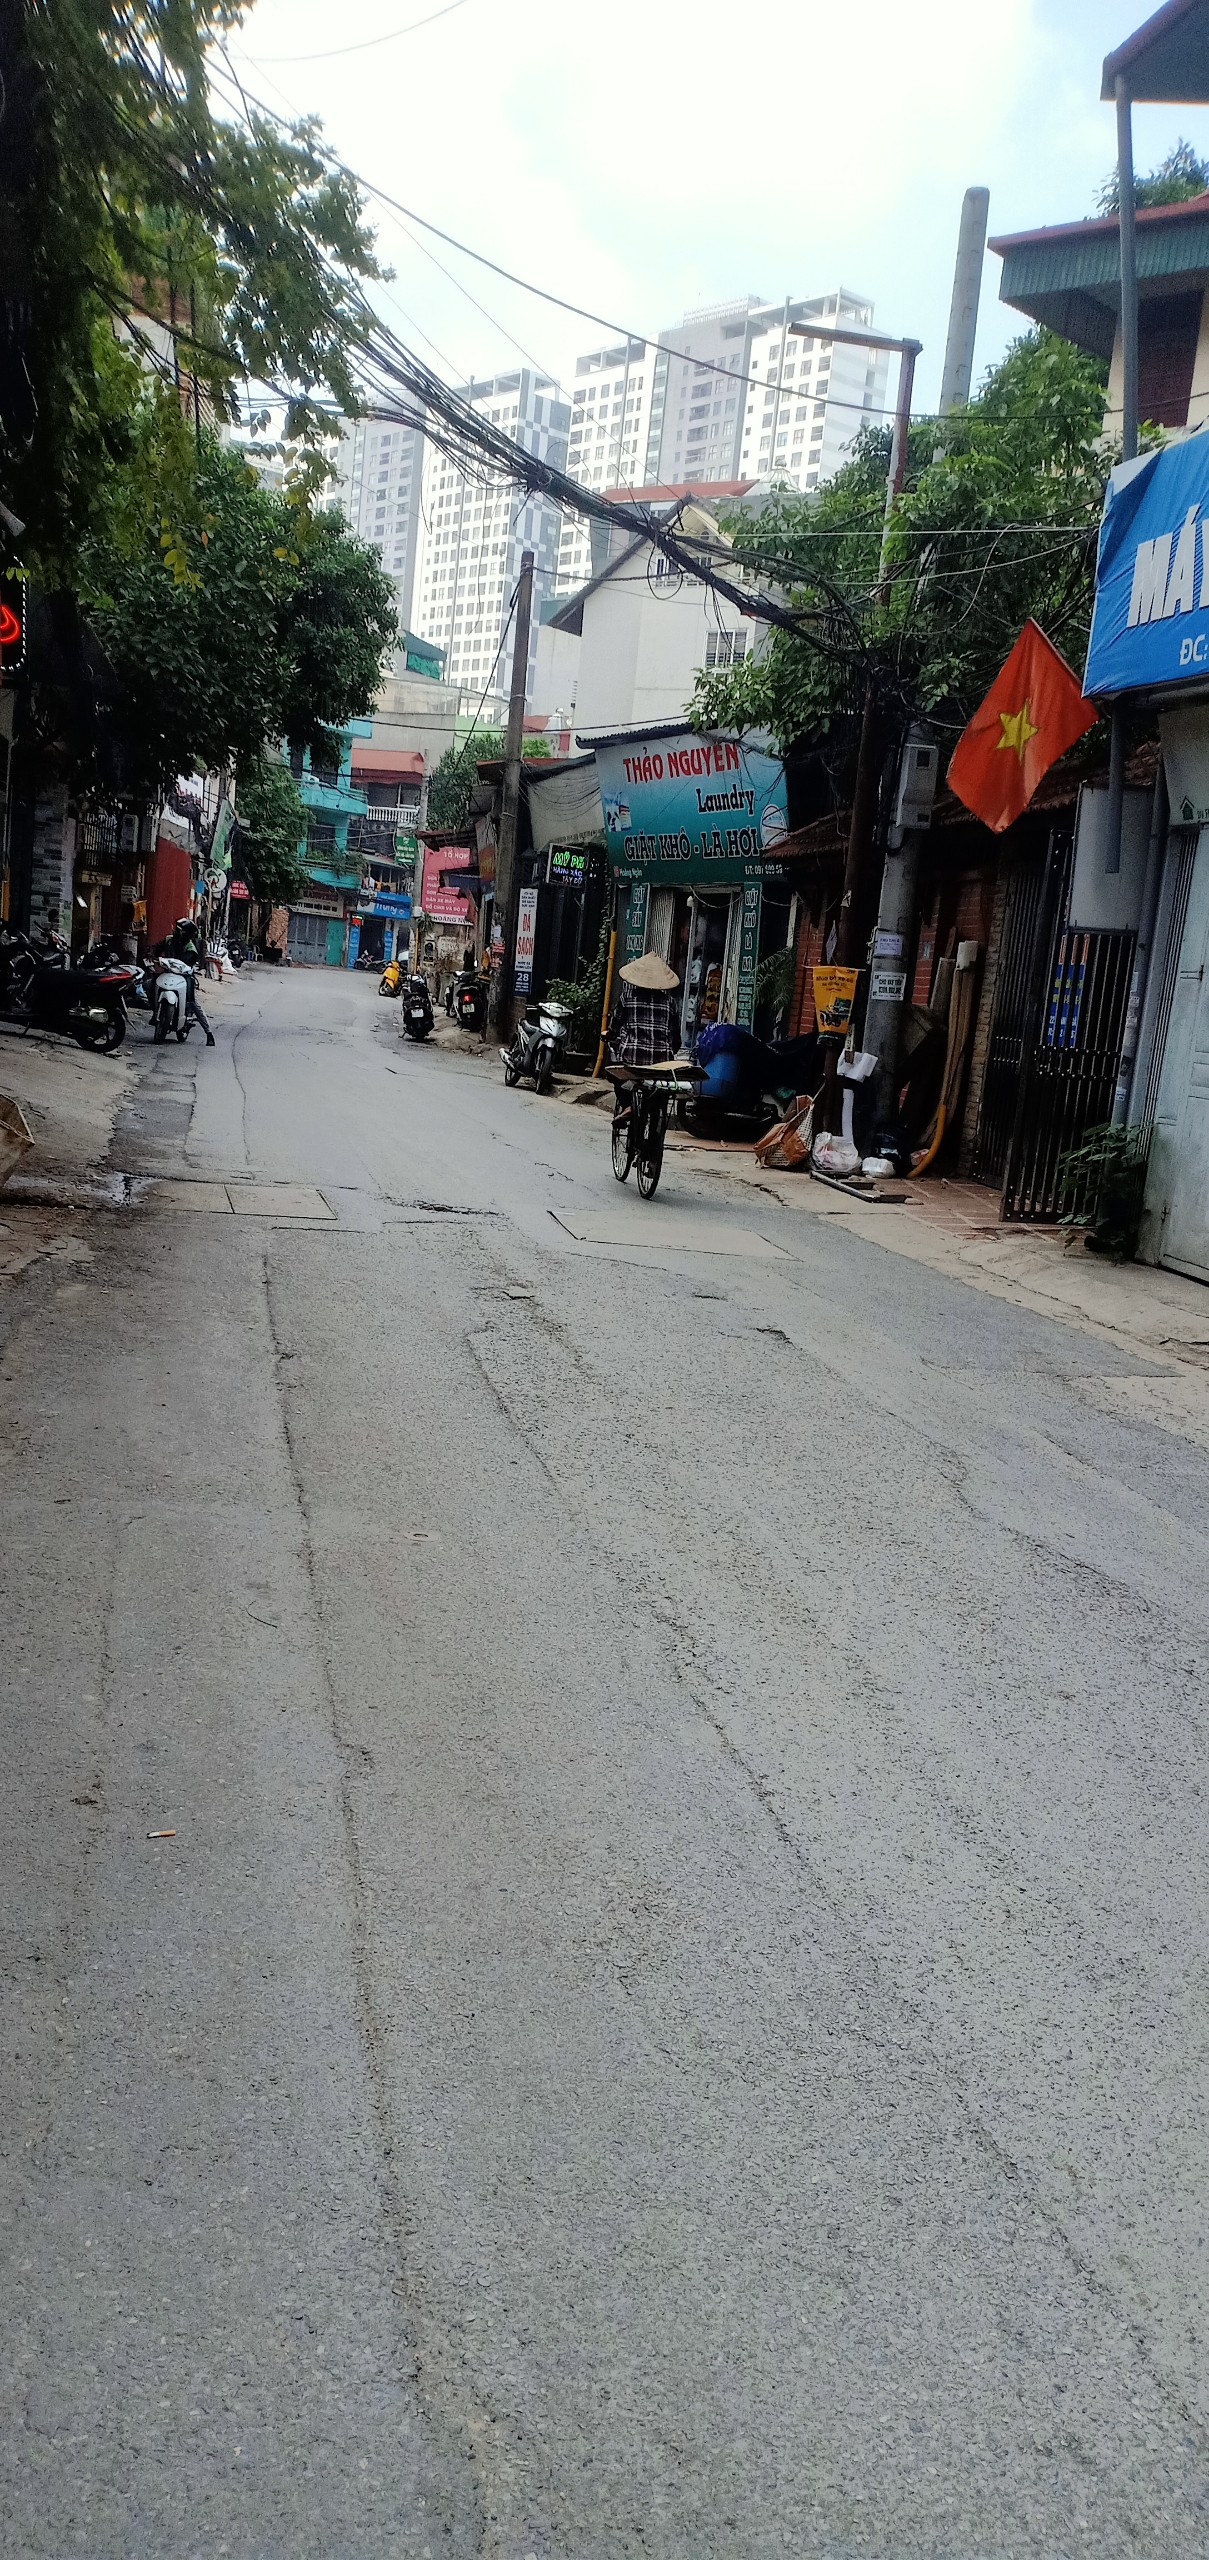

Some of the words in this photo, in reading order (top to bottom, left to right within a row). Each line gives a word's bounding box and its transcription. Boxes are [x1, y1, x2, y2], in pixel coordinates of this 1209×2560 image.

[1179, 634, 1208, 666] ĐC:
[622, 747, 664, 784] THẢO
[695, 783, 755, 816] Laundry
[624, 831, 657, 866] GIẶT
[658, 826, 691, 861] KHÔ
[701, 823, 725, 859] LÀ
[726, 827, 760, 857] HƠI
[516, 972, 529, 982] 28
